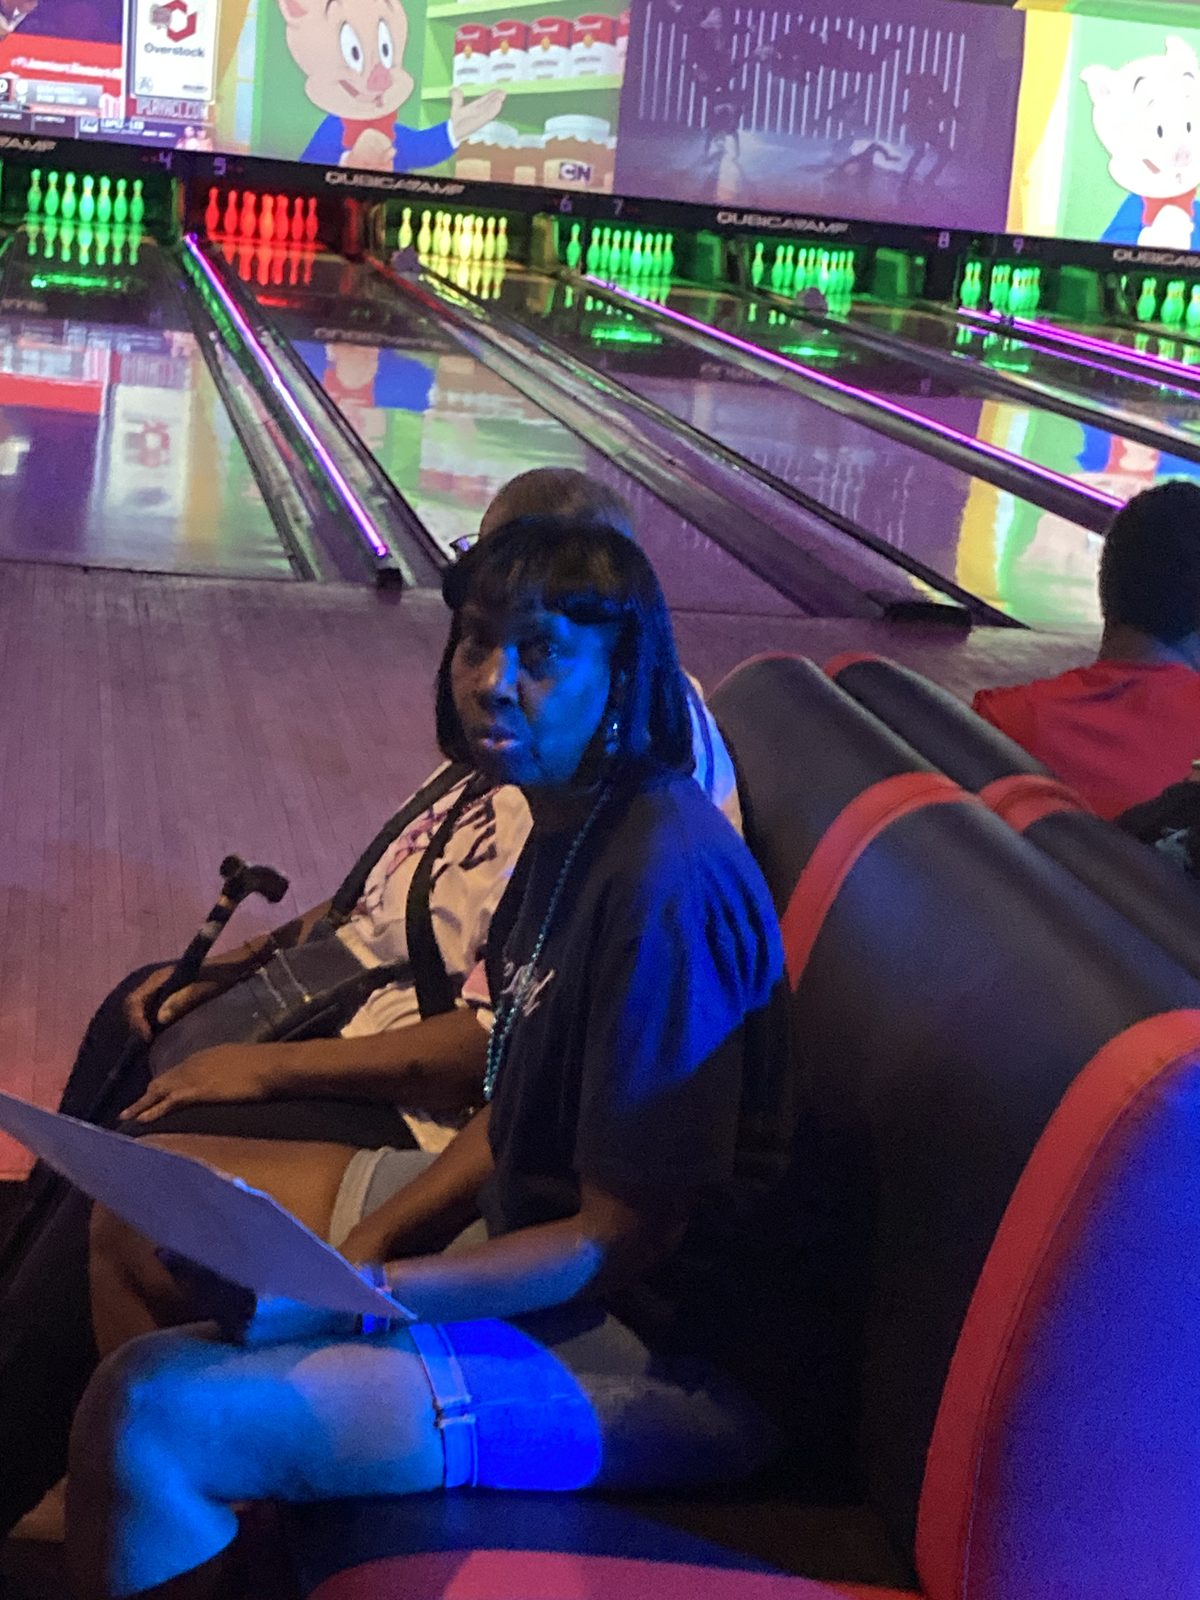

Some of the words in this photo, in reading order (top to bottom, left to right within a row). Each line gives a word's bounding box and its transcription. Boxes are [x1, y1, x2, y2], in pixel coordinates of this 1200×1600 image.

[144, 41, 206, 58] Overstock
[159, 151, 172, 170] 4
[559, 162, 591, 183] CN
[560, 193, 573, 213] 6
[612, 198, 624, 215] 7
[937, 231, 949, 248] 8
[1013, 237, 1025, 254] 9
